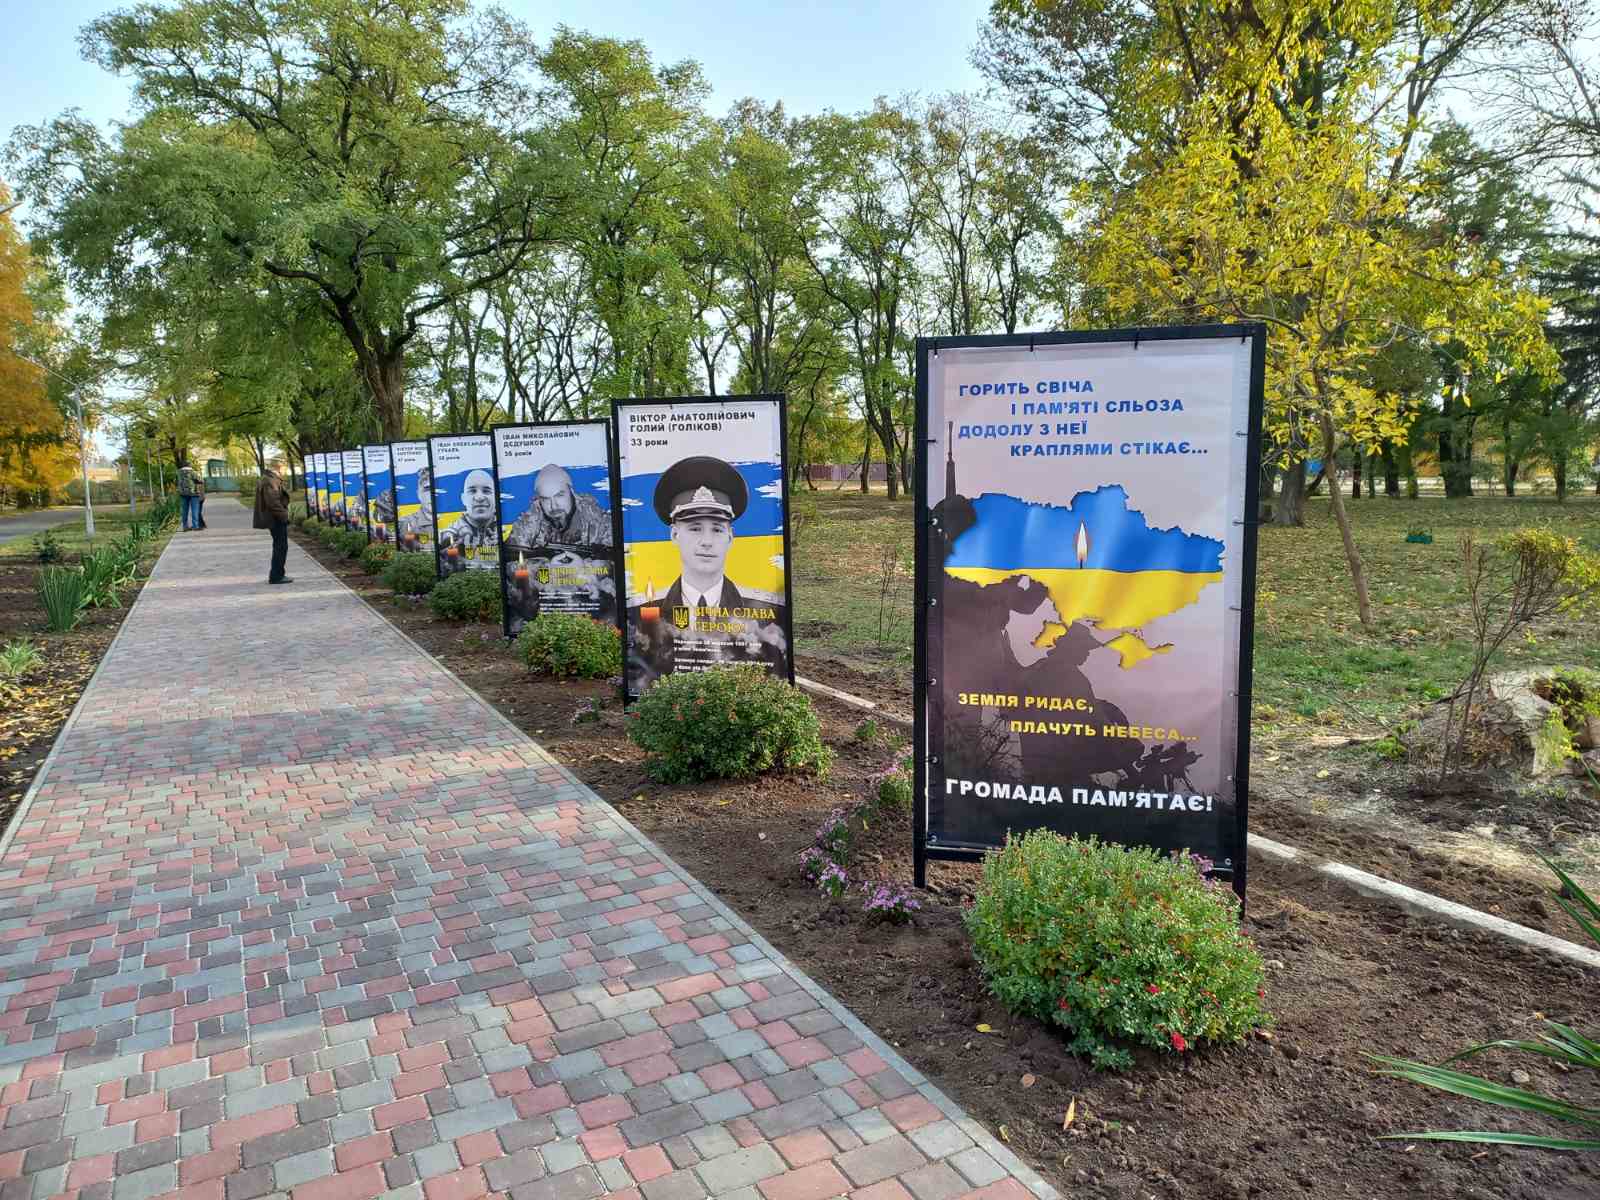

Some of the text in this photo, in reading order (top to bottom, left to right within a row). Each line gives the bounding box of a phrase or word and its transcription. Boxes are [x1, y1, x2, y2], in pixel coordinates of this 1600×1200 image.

[959, 380, 1094, 397] ГОРИТЬ СВІЧА
[1011, 399, 1184, 416] І ПАМ’ЯТІ СЛЬОЗА
[630, 411, 755, 423] ВІКТОР АНАТОЛІЙОВИЧ
[630, 422, 722, 433] ГОЛИЙ (ГОЛІКОВ)
[958, 420, 1088, 439] ДОДОЛУ З НЕЇ
[503, 431, 580, 441] ІВАН МИКОЛАЙОВИЧ
[631, 438, 668, 448] 33 роки
[1010, 441, 1208, 457] КРАПЛЯМИ СТІКАЄ...
[733, 607, 776, 620] СЛАВА
[958, 693, 1094, 714] ЗЕМЛЯ РИДАЄ,
[1010, 720, 1197, 741] ПЛАЧУТЬ НЕБЕСА...
[945, 778, 1213, 812] ГРОМАДА ПАМ’ЯТАЄ!
